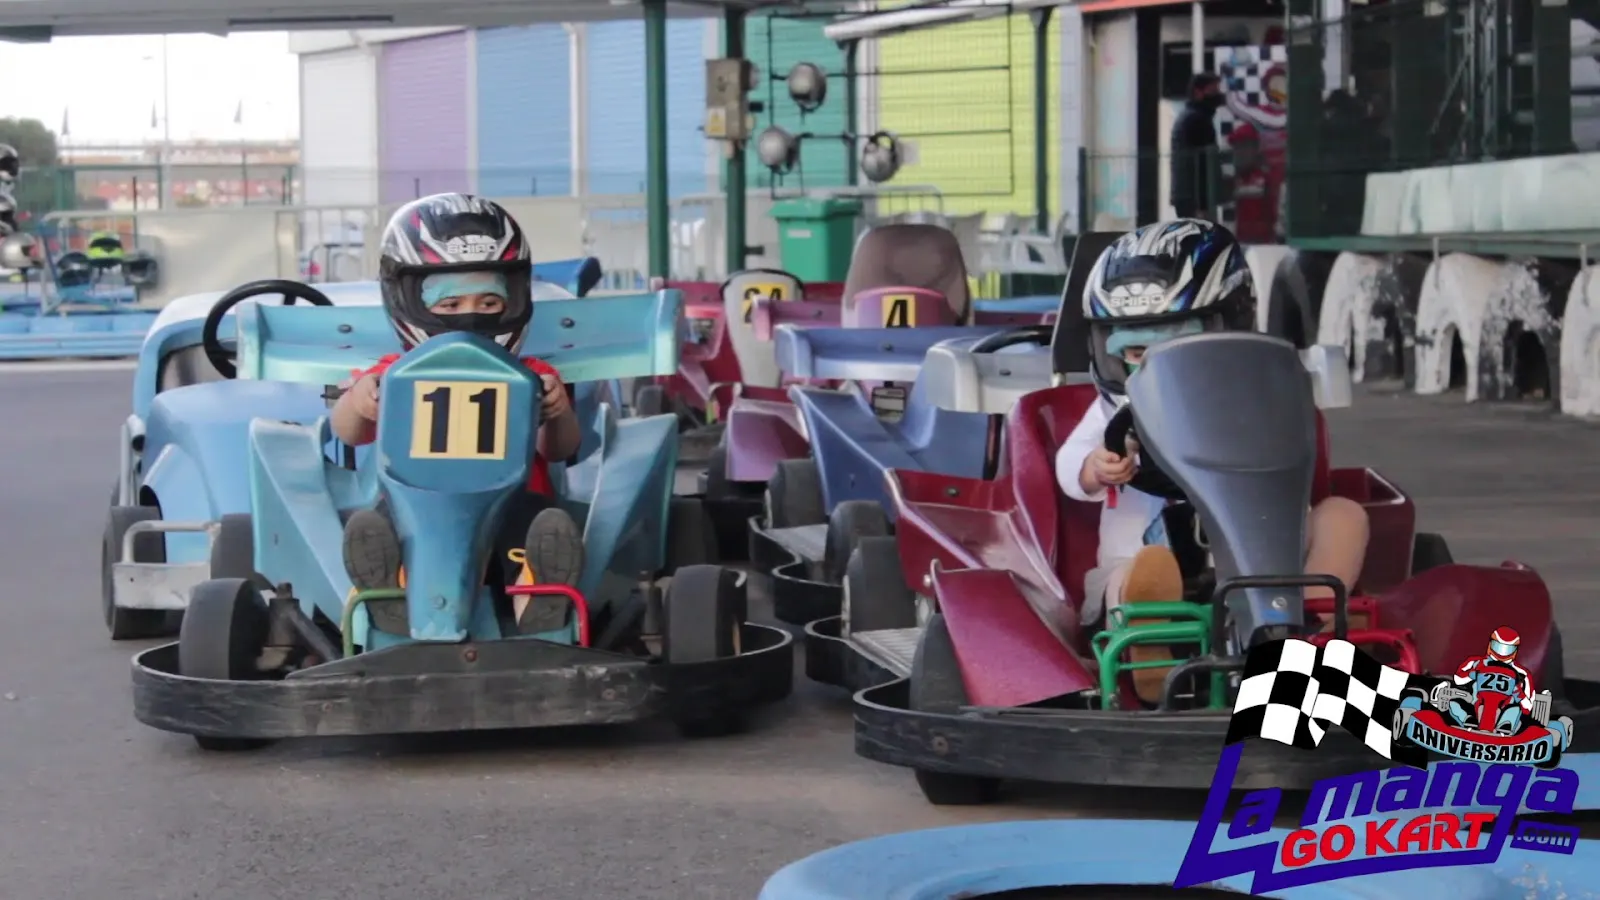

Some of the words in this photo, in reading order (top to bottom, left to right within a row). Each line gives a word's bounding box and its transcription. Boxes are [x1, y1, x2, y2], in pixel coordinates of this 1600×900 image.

[447, 243, 498, 255] SHIRO
[1109, 294, 1166, 308] SHIRO
[422, 386, 497, 454] 11
